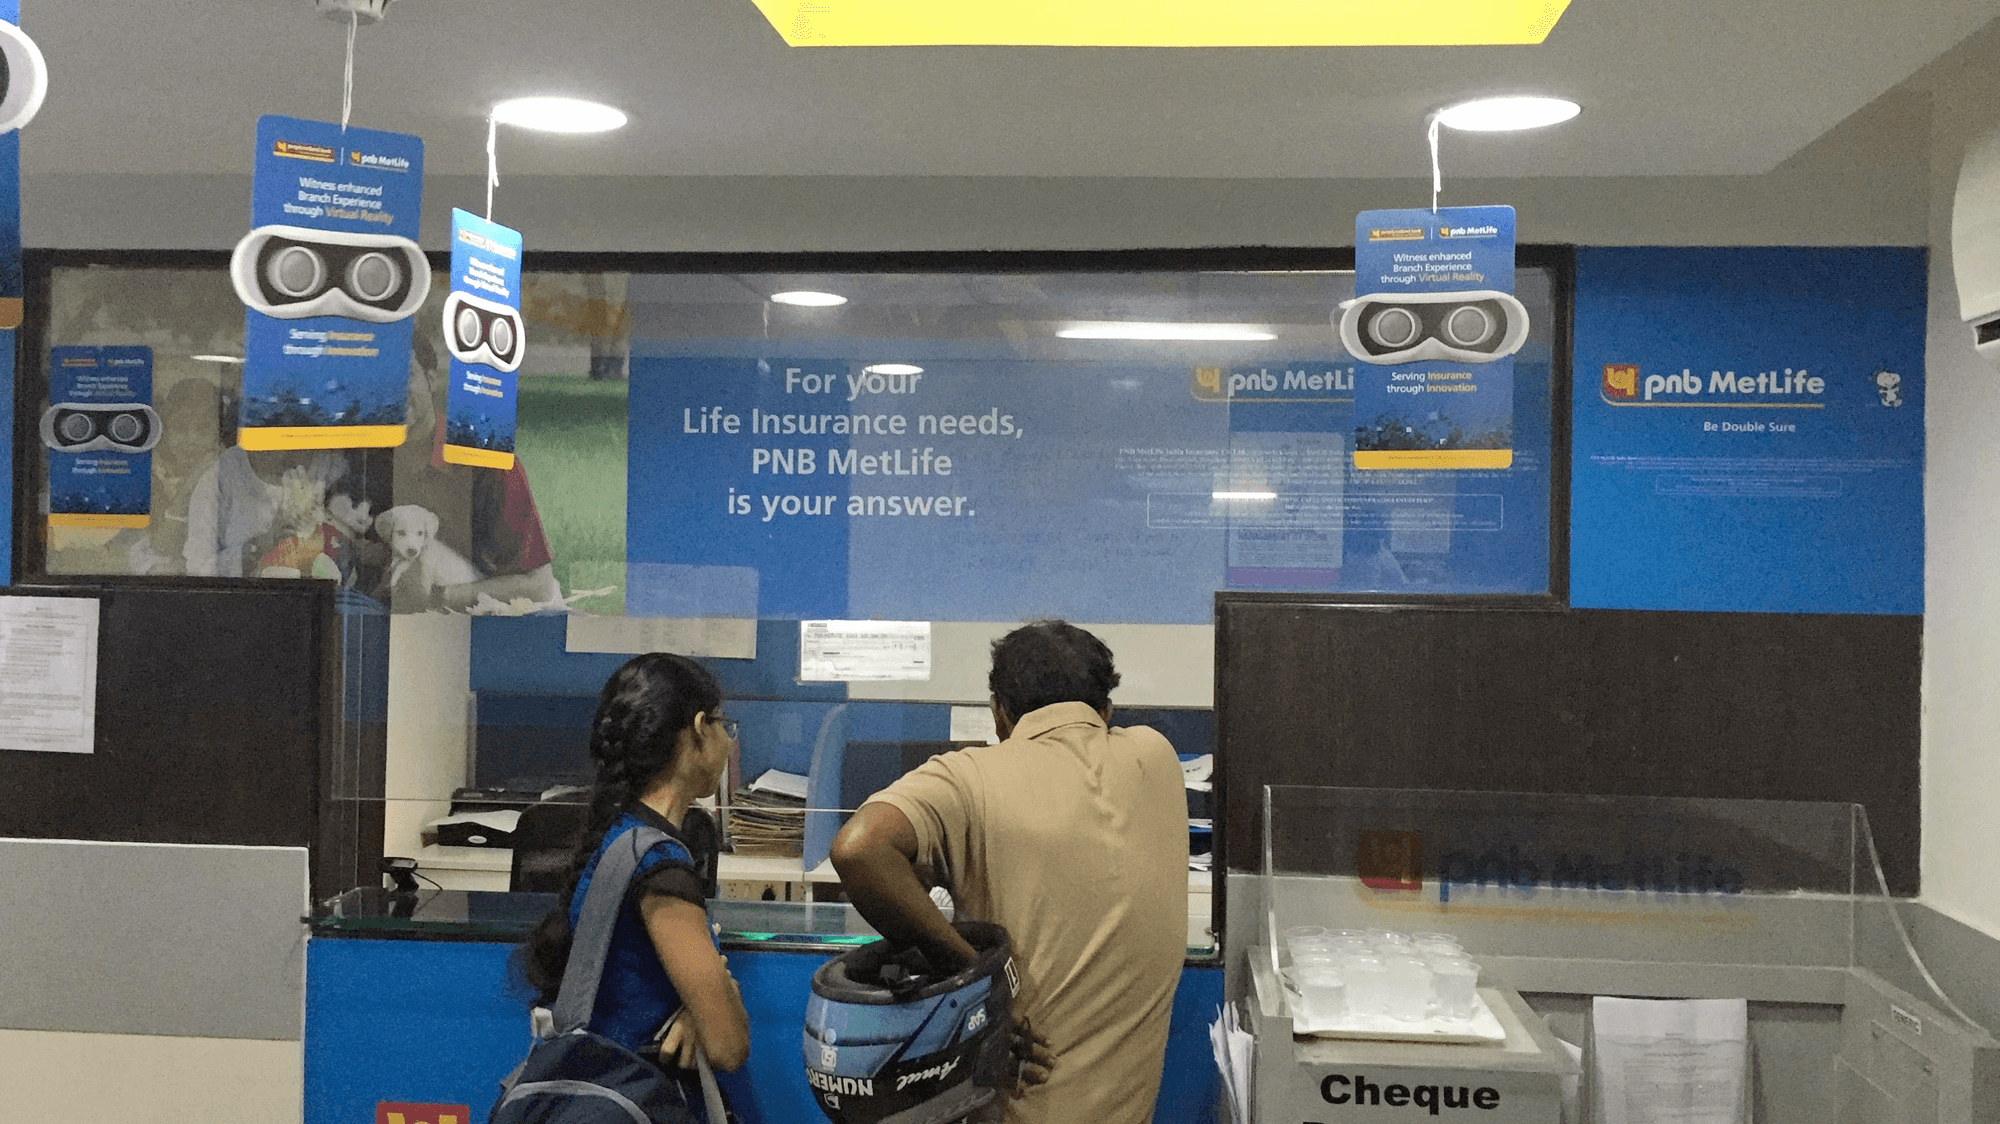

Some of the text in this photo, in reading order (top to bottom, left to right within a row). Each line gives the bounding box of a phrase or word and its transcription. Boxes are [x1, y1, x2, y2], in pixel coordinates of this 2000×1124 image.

[299, 177, 383, 197] Witness enhanced
[298, 190, 382, 210] Branch Experience
[1450, 225, 1498, 236] pnb MetLife
[1393, 251, 1472, 262] Witness enhanced
[1380, 272, 1485, 285] through Virtual Reality
[1393, 263, 1472, 274] Branch Experience
[785, 367, 922, 401] For your
[1228, 367, 1354, 397] pnb MetLi
[1391, 371, 1473, 382] Serving Insurance
[1645, 367, 1825, 400] pnb MetLife
[1387, 383, 1477, 395] through Innovation
[683, 406, 1024, 439] Life Insurance needs,
[1703, 421, 1796, 433] Be Double Sure
[752, 446, 953, 476] PNB MetLife
[728, 487, 976, 522] is your answer.
[1320, 1074, 1501, 1116] Cheque
